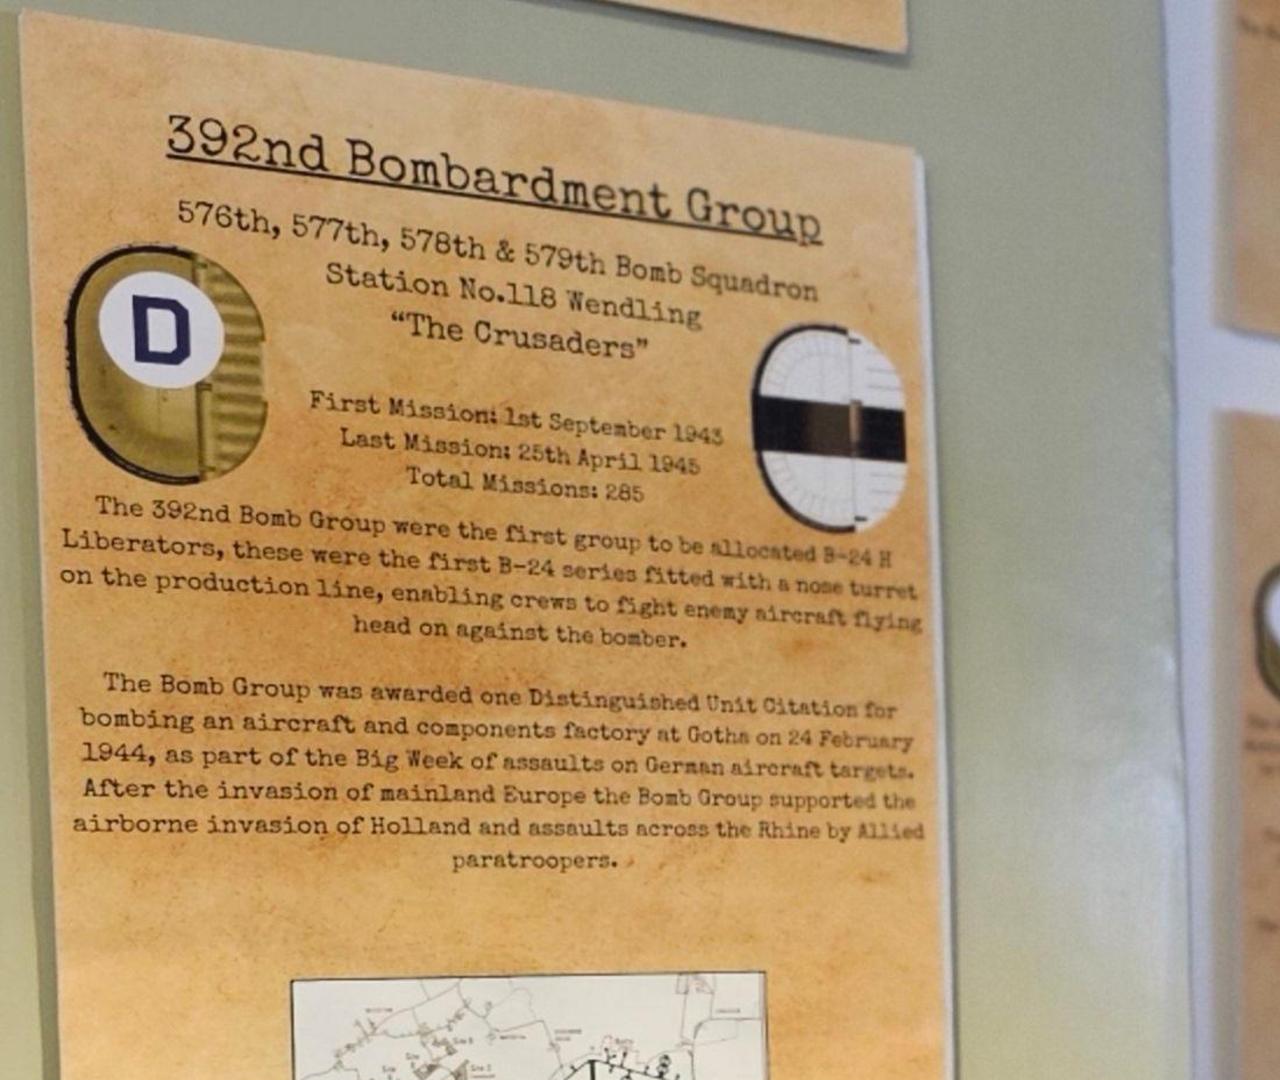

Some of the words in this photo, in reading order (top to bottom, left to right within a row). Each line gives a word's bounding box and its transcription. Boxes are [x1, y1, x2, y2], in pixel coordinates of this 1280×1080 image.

[168, 114, 329, 172] 392nd
[345, 138, 671, 219] Bombardment
[687, 187, 822, 246] Group
[179, 199, 280, 240] 576th,
[293, 213, 389, 253] 577th,
[401, 227, 485, 261] 578th
[496, 239, 514, 264] &
[525, 242, 605, 276] 579th
[616, 253, 682, 285] Bomb
[691, 264, 818, 303] Squadron
[327, 262, 449, 298] Station
[459, 276, 556, 310] No.118
[567, 290, 702, 332] Wendling
[132, 295, 190, 367] D
[311, 389, 380, 415] First
[389, 396, 498, 426] Mission:
[505, 406, 542, 430] 1st
[549, 412, 666, 441] September
[674, 422, 724, 447] 1943
[340, 427, 395, 451] Last
[404, 432, 510, 461] Mission:
[518, 444, 570, 466] 25th
[578, 447, 642, 473] April
[650, 453, 700, 476] 1945
[406, 464, 473, 491] Total
[483, 472, 598, 499] Missions:
[606, 482, 644, 503] 285
[95, 494, 143, 518] The
[152, 499, 230, 524] 392nd
[240, 504, 301, 528] Bomb
[310, 510, 385, 539] Group
[393, 520, 450, 538] were
[458, 521, 497, 541] the
[506, 523, 567, 546] first
[574, 533, 640, 556] group
[648, 534, 673, 554] to
[679, 535, 703, 555] be
[711, 538, 816, 564] allocated
[824, 545, 872, 567] B-24
[879, 549, 891, 569] H
[62, 528, 224, 561] Liberators,
[233, 540, 303, 563] these
[311, 548, 370, 566] were
[379, 549, 420, 570] the
[429, 551, 491, 574] first
[498, 555, 554, 578] B-24
[563, 562, 637, 583] series
[645, 564, 714, 587] fitted
[721, 571, 771, 591] with
[778, 578, 790, 592] a
[795, 579, 843, 596] nose
[849, 579, 918, 601] turret
[60, 569, 92, 585] on
[101, 566, 146, 588] the
[156, 571, 309, 597] production
[317, 578, 383, 604] line,
[392, 584, 504, 611] enabling
[511, 594, 577, 611] crews
[585, 595, 609, 613] to
[617, 595, 677, 620] fight
[684, 604, 748, 625] enemy
[756, 605, 847, 628] aircraft
[853, 609, 922, 636] flying
[353, 614, 411, 636] head
[420, 621, 448, 638] on
[457, 621, 548, 644] against
[556, 625, 593, 644] the
[600, 627, 687, 649] bomber.
[103, 671, 151, 694] The
[161, 673, 223, 696] Bomb
[233, 677, 310, 704] Group
[319, 684, 362, 700] was
[371, 684, 473, 704] awarded
[480, 691, 521, 706] one
[528, 687, 700, 714] Distinguished
[707, 694, 757, 715] Unit
[763, 696, 858, 718] Citation
[864, 699, 897, 720] for
[79, 706, 194, 734] bombing
[203, 715, 234, 731] an
[243, 712, 355, 734] aircraft
[364, 716, 409, 735] and
[417, 721, 556, 742] components
[564, 721, 650, 746] factory
[658, 725, 680, 743] at
[688, 725, 749, 745] Gotha
[756, 732, 782, 746] on
[789, 729, 812, 746] 24
[819, 728, 914, 755] February
[82, 742, 155, 767] 1944,
[165, 749, 193, 764] as
[202, 747, 261, 769] part
[270, 747, 298, 767] of
[305, 747, 346, 768] the
[356, 748, 399, 774] Big
[406, 749, 463, 770] Week
[471, 752, 498, 771] of
[503, 753, 604, 773] assaults
[611, 759, 637, 774] on
[646, 755, 724, 776] German
[731, 758, 823, 779] aircraft
[830, 760, 914, 782] targets.
[84, 778, 155, 798] After
[165, 779, 208, 799] the
[218, 780, 337, 802] invasion
[347, 782, 374, 802] of
[381, 784, 495, 803] mainland
[504, 785, 586, 808] Europe
[593, 786, 630, 805] the
[638, 786, 691, 807] Bomb
[698, 788, 762, 812] Group
[770, 791, 876, 814] supported
[883, 792, 915, 810] the
[73, 813, 198, 834] airborne
[208, 814, 328, 835] invasion
[337, 815, 364, 839] of
[371, 816, 471, 836] Holland
[480, 817, 520, 836] and
[529, 819, 628, 838] assaults
[636, 823, 709, 838] across
[715, 820, 751, 839] the
[759, 820, 820, 839] Rhine
[827, 822, 851, 844] by
[858, 822, 924, 840] Allied
[453, 851, 618, 874] paratroopers.
